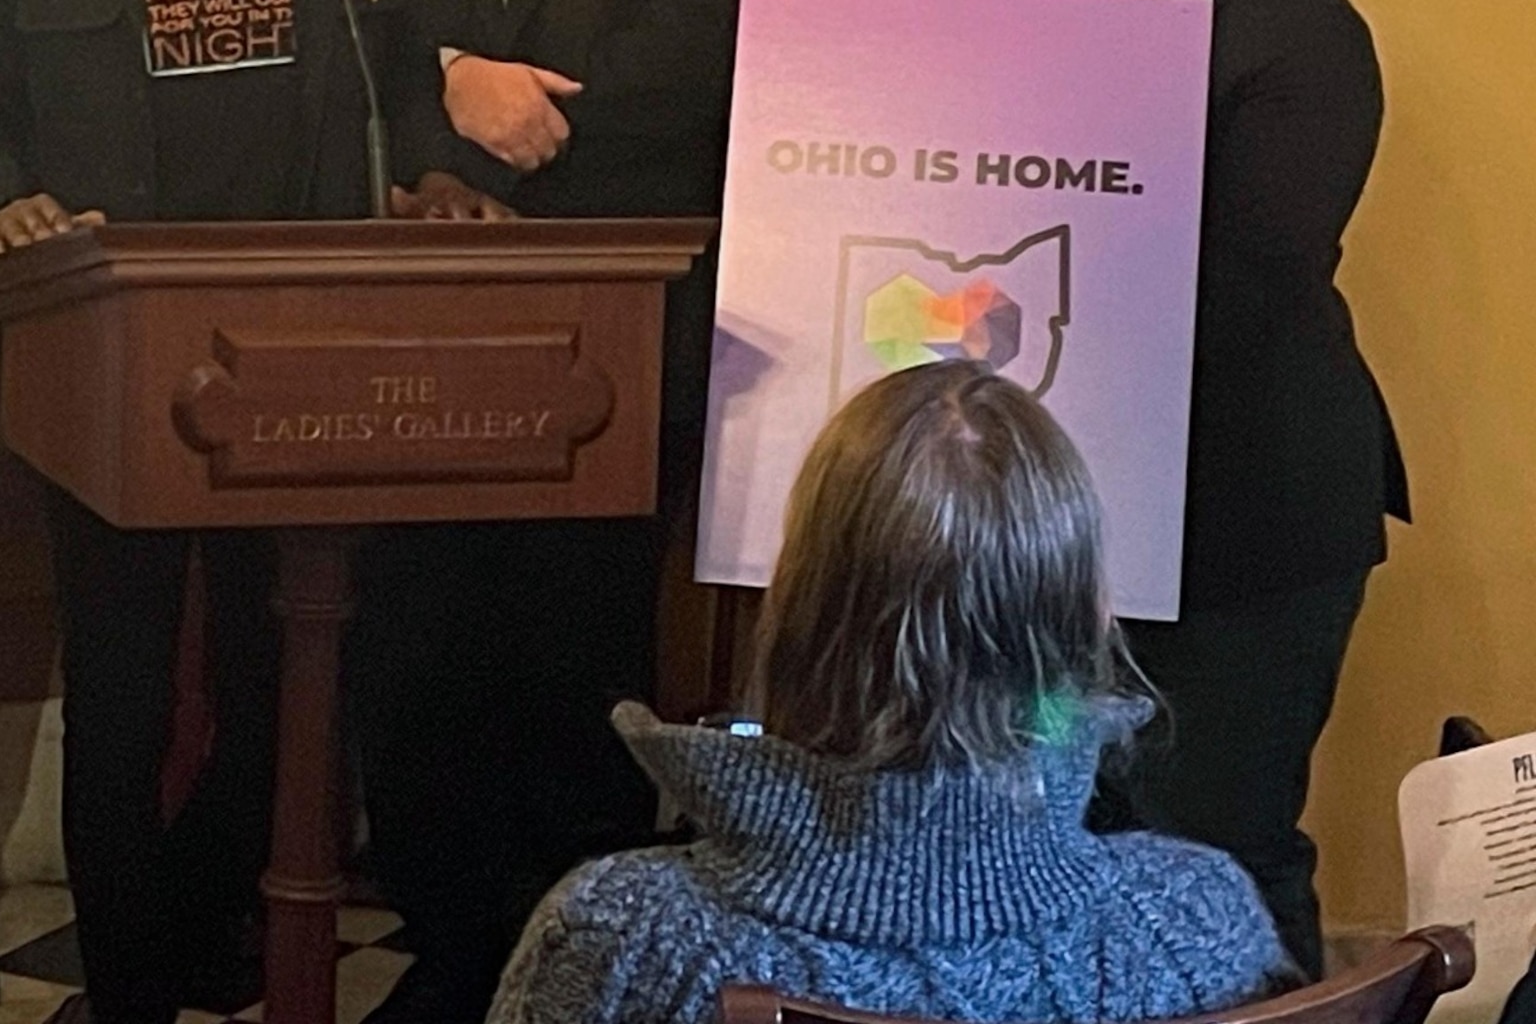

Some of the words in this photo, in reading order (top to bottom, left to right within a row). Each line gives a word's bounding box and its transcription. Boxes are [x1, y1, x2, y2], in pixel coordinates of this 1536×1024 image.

[148, 0, 199, 22] THEY
[199, 11, 243, 27] YOU
[248, 9, 270, 22] IN
[766, 139, 897, 179] OHIO
[914, 149, 959, 183] IS
[976, 152, 1144, 195] HOME.
[370, 376, 437, 404] THE
[393, 410, 551, 440] GALLERY
